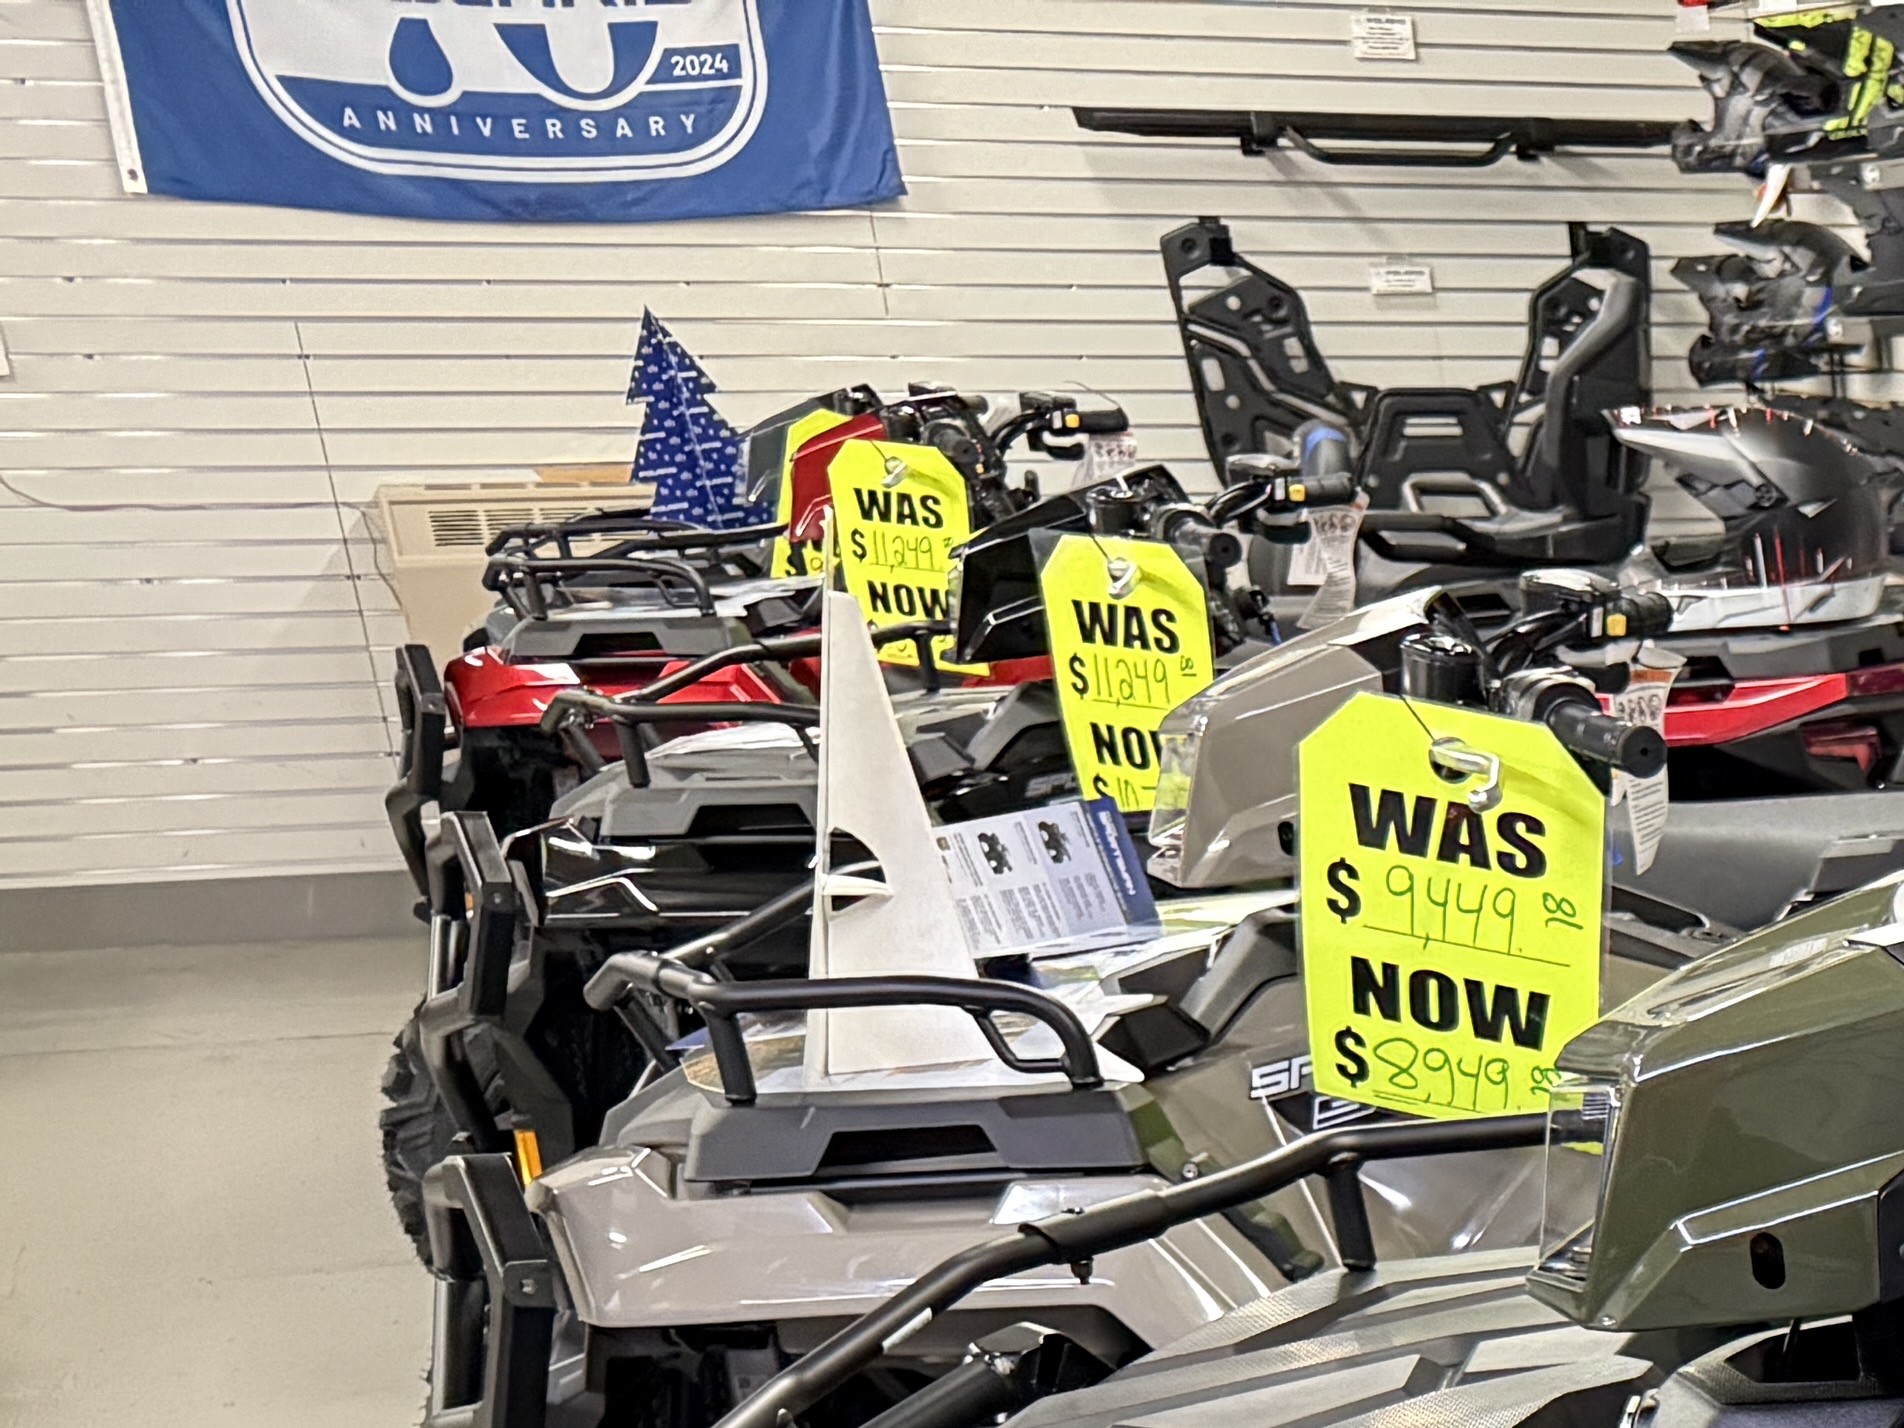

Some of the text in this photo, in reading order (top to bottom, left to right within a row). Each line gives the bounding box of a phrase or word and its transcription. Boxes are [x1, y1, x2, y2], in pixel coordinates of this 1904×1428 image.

[670, 53, 730, 78] 2024
[341, 106, 698, 140] ANNIVERSARY
[854, 487, 944, 528] WAS
[1072, 599, 1181, 655] WAS
[1089, 722, 1162, 771] NO
[1348, 782, 1548, 879] WAS
[1350, 956, 1551, 1051] NOW
